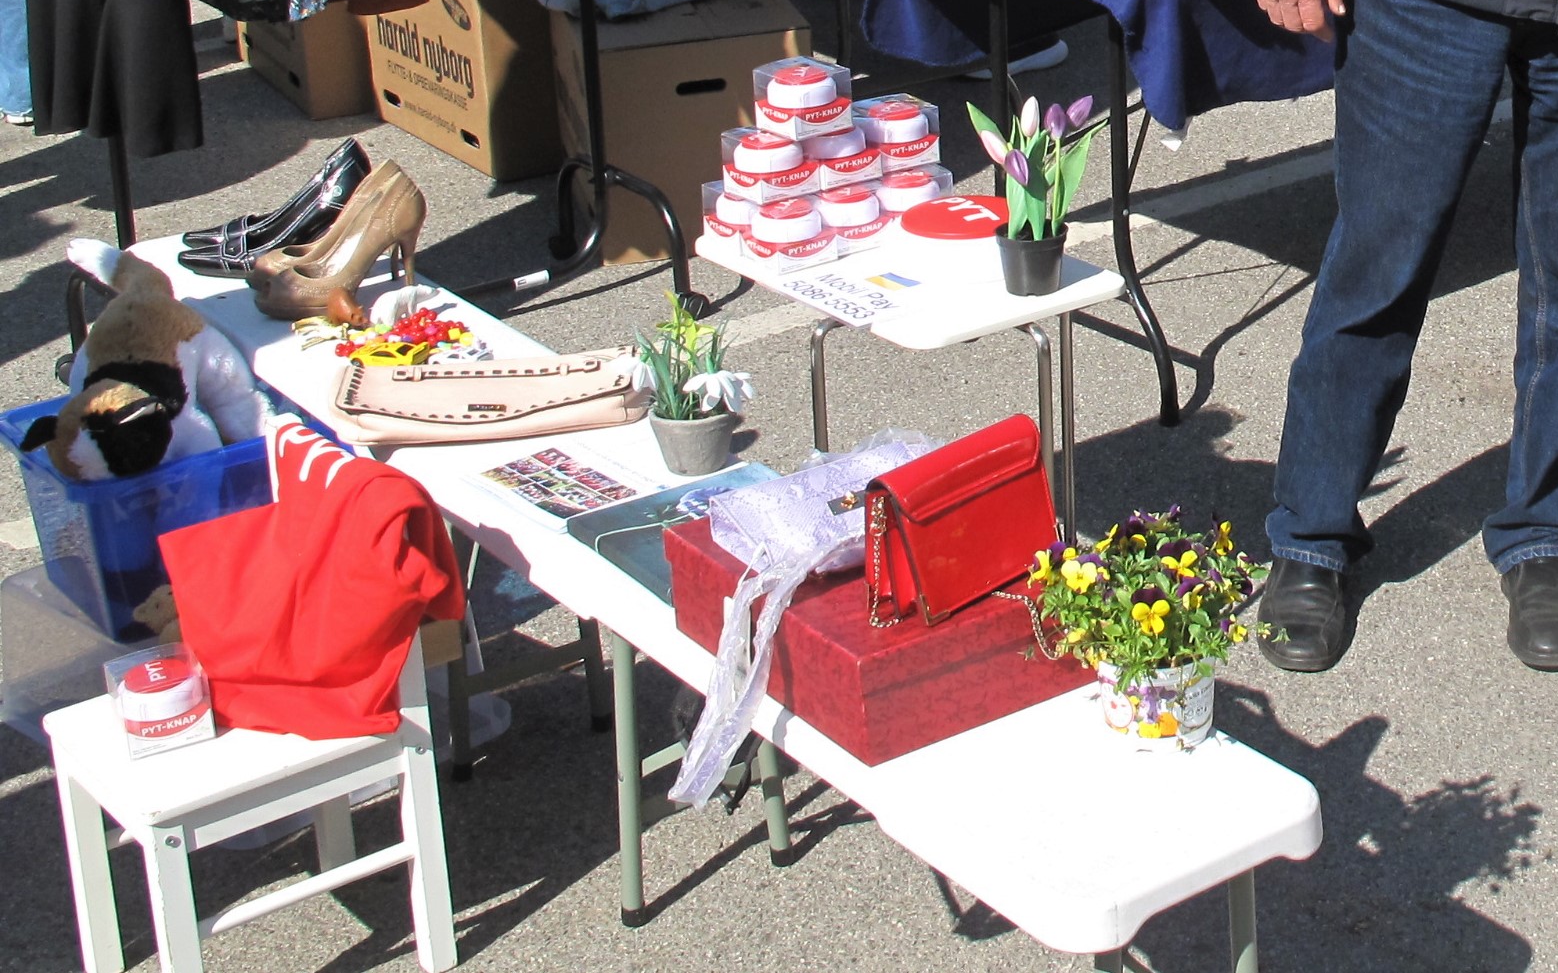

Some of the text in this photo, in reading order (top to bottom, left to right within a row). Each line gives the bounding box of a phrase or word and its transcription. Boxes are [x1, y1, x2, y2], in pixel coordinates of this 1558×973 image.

[376, 14, 474, 99] harald nyborg
[762, 107, 789, 120] PYT-KNAP
[806, 106, 843, 121] PYT-KNAP
[890, 141, 930, 156] PYT-KNAP
[834, 156, 873, 170] PYT-KNAP
[772, 171, 810, 185] PYT-KNAP
[930, 197, 1001, 223] PYT
[844, 222, 883, 238] PYT-KNAP
[788, 240, 828, 256] PYT-KNAP
[783, 280, 875, 319] 5086 5553
[815, 273, 901, 310] Mobil Pay
[144, 660, 166, 683] PYT
[141, 714, 197, 736] PYT-KNAP
